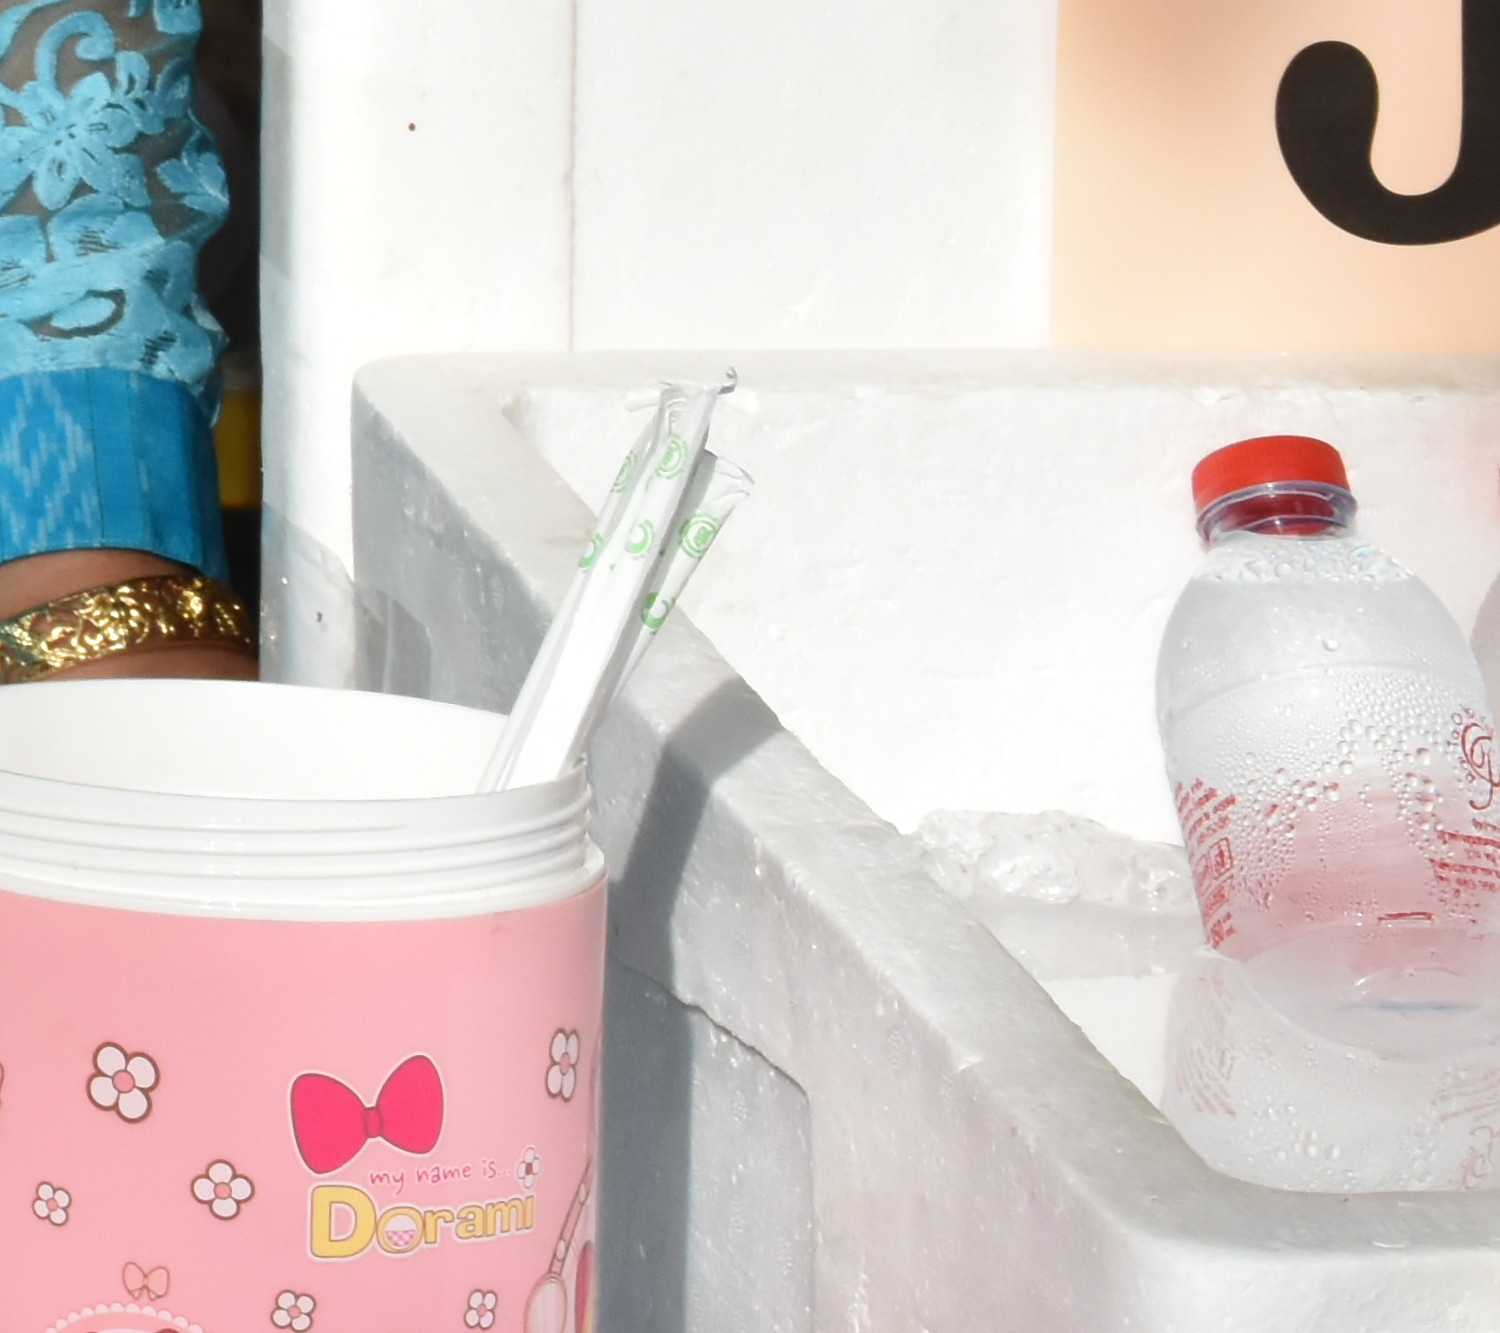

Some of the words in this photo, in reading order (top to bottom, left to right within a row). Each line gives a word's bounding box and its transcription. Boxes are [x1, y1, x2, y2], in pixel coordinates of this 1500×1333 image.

[370, 1171, 405, 1197] my
[416, 1164, 473, 1184] name
[309, 1184, 536, 1259] Dorami
